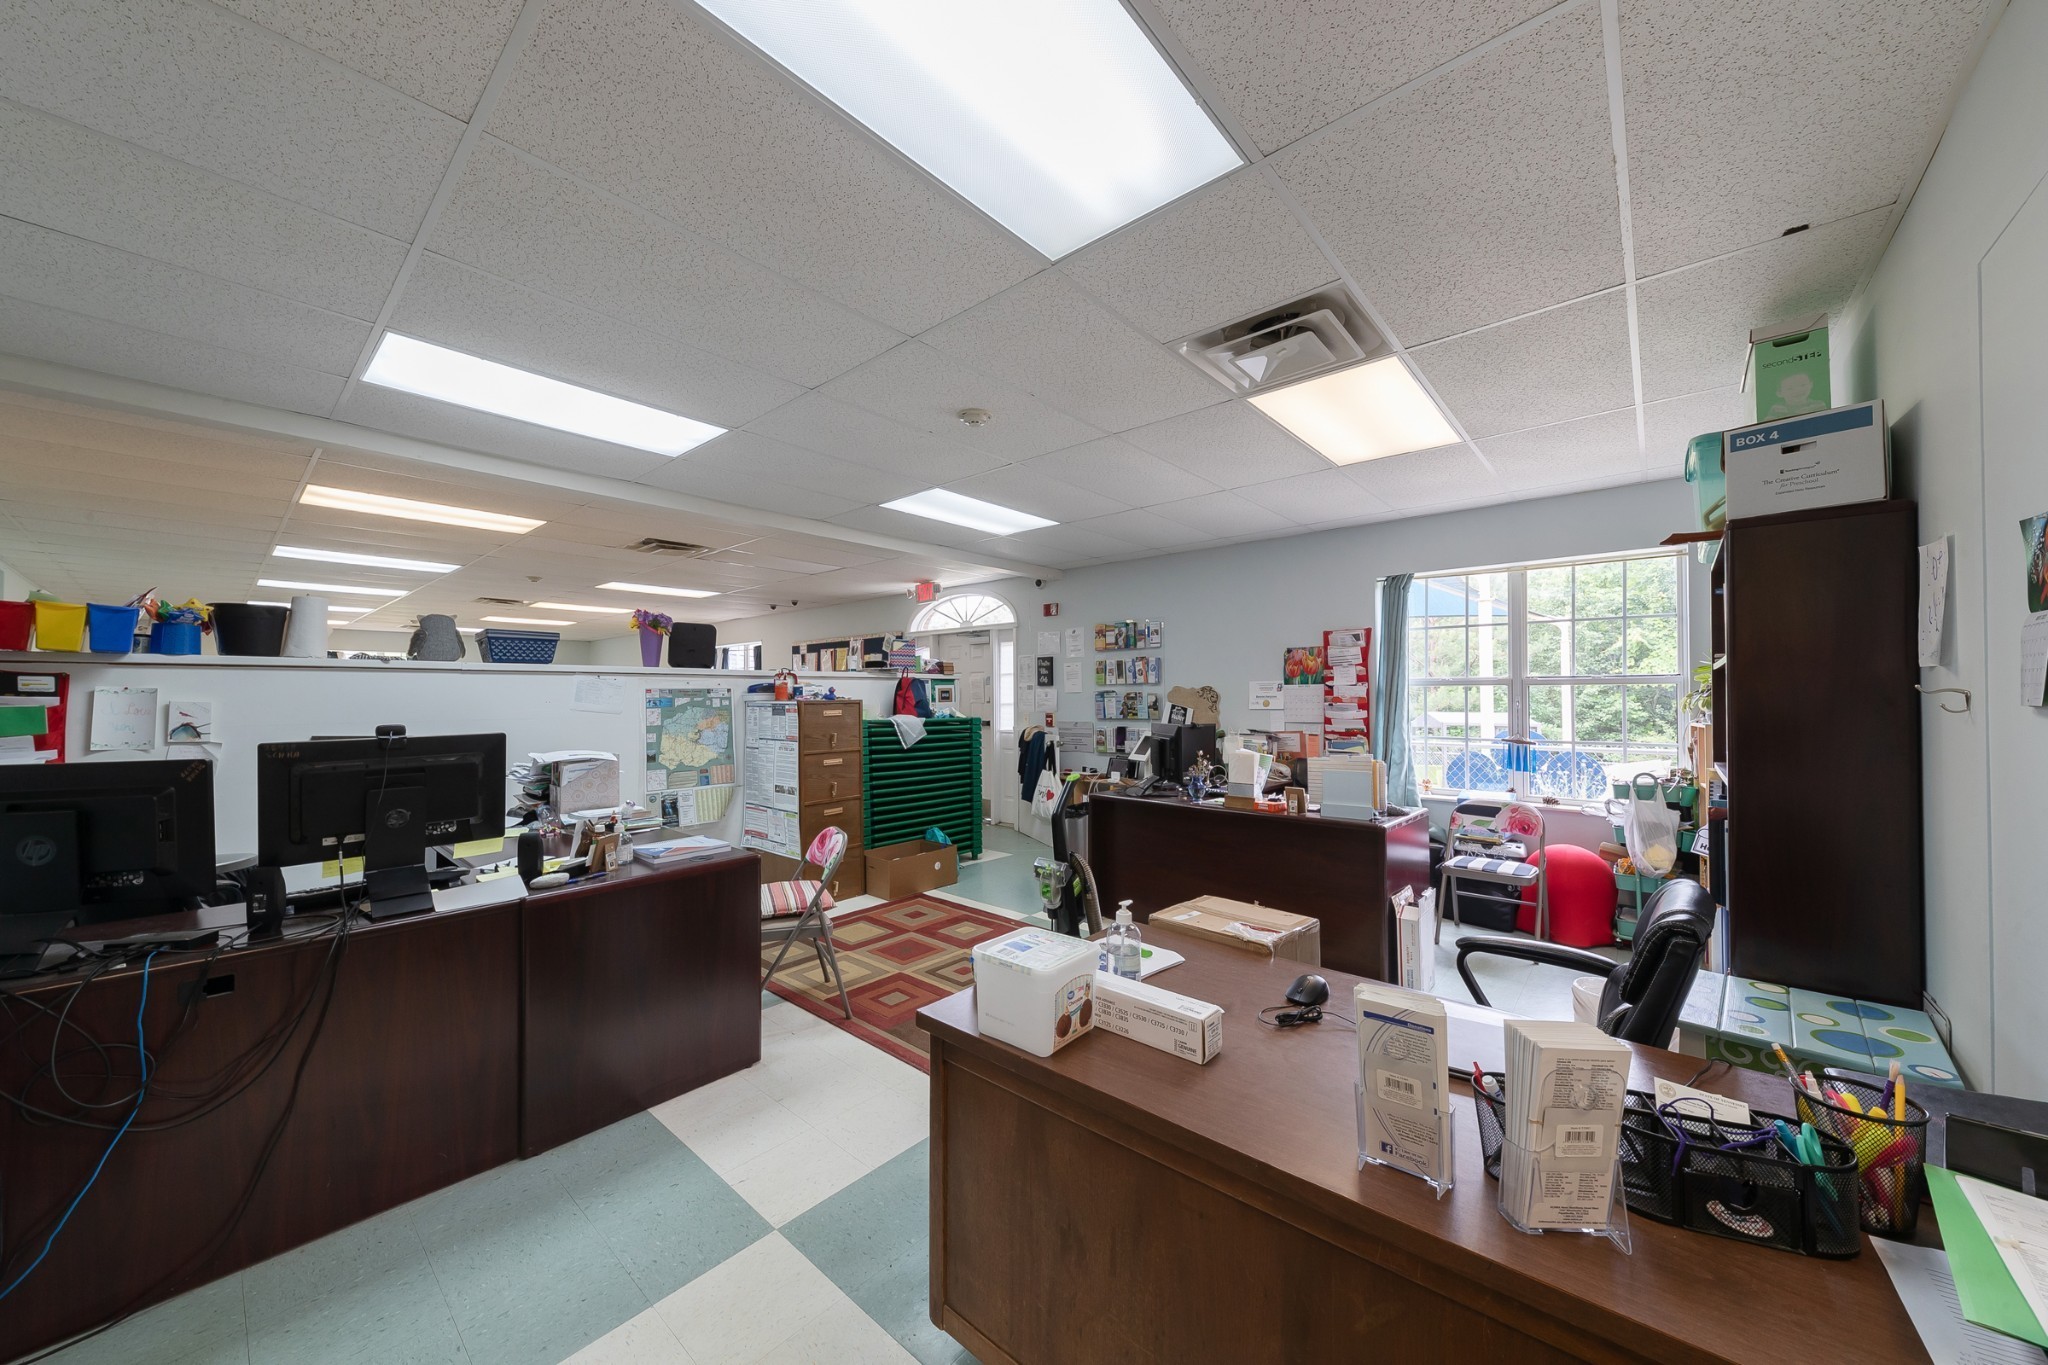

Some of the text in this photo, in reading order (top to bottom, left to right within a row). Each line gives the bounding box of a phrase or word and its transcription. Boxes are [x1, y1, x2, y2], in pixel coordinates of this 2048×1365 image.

[1736, 430, 1780, 447] BOX 4
[1178, 1043, 1197, 1054] GENUINE
[1395, 1151, 1427, 1167] Facebook
